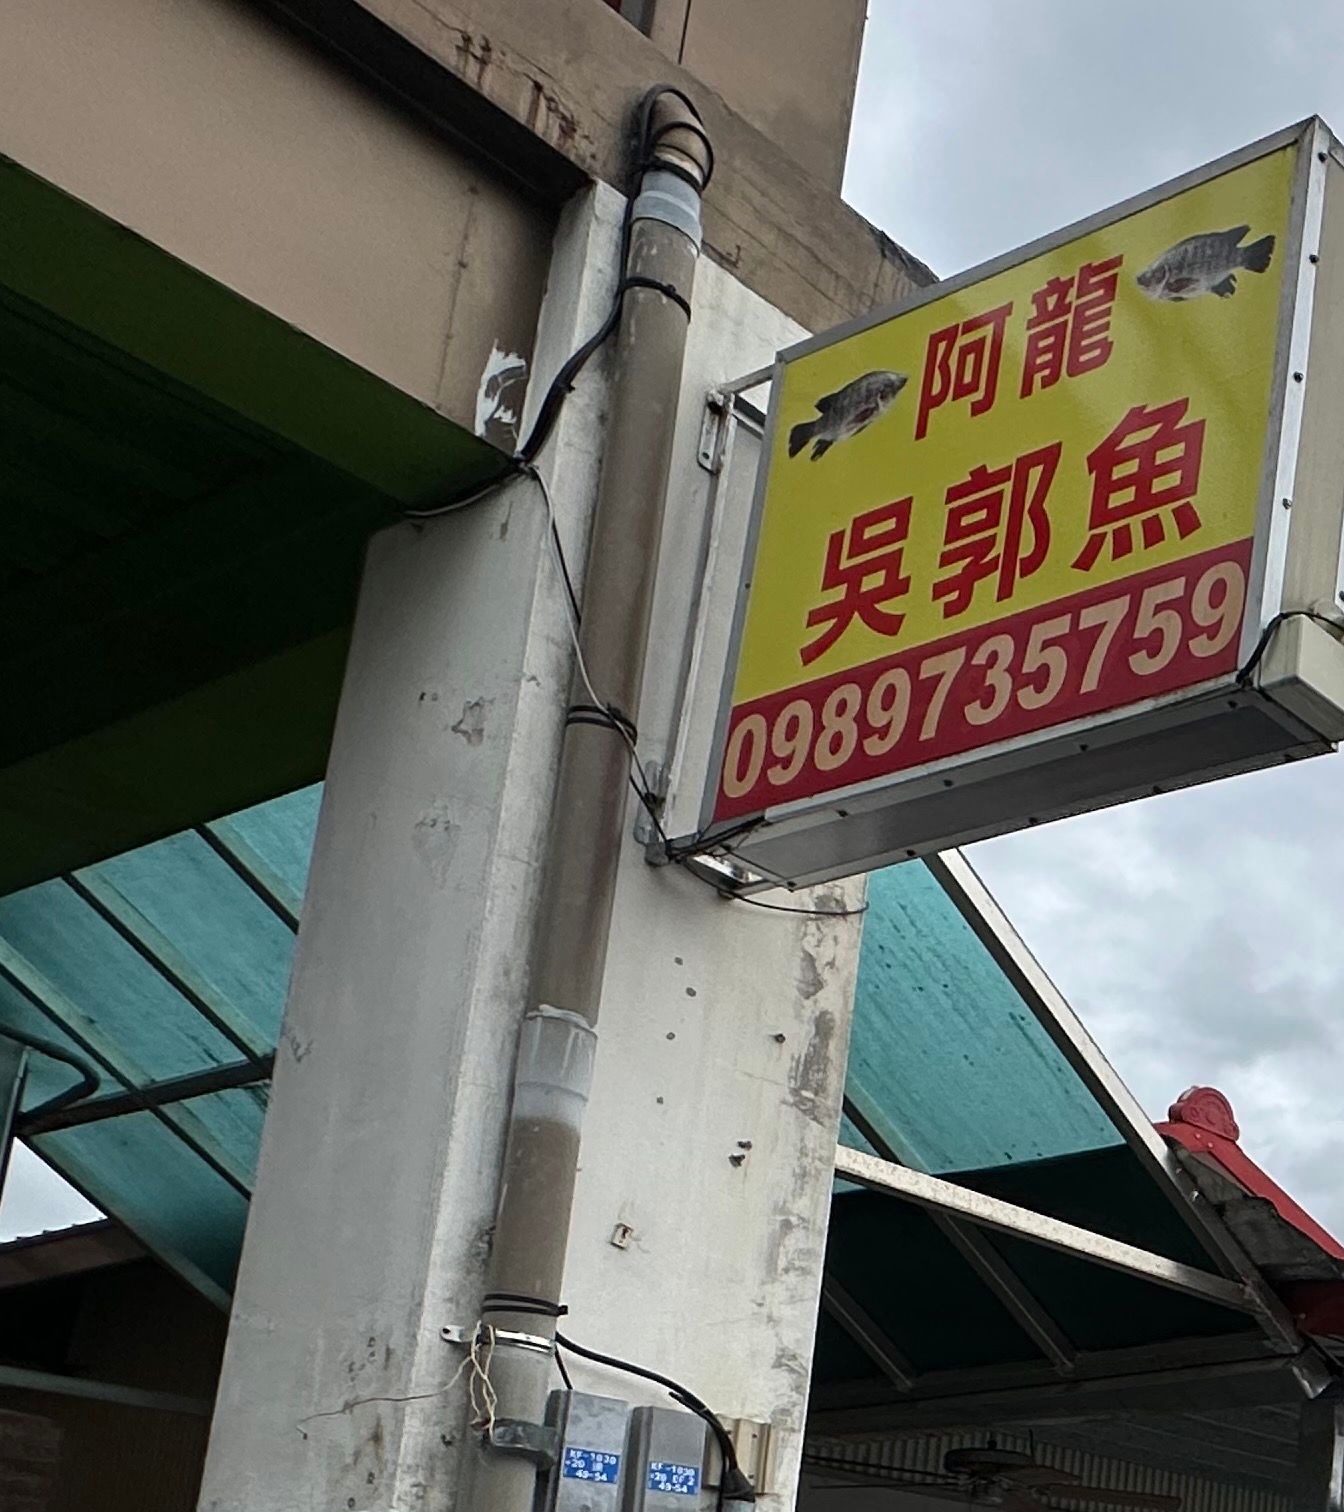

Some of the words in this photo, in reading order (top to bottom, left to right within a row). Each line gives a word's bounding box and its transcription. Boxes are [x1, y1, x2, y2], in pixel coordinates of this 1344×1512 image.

[914, 253, 1124, 441] 阿龍
[799, 398, 1208, 667] 吳郭魚
[721, 559, 1247, 799] 0989735759
